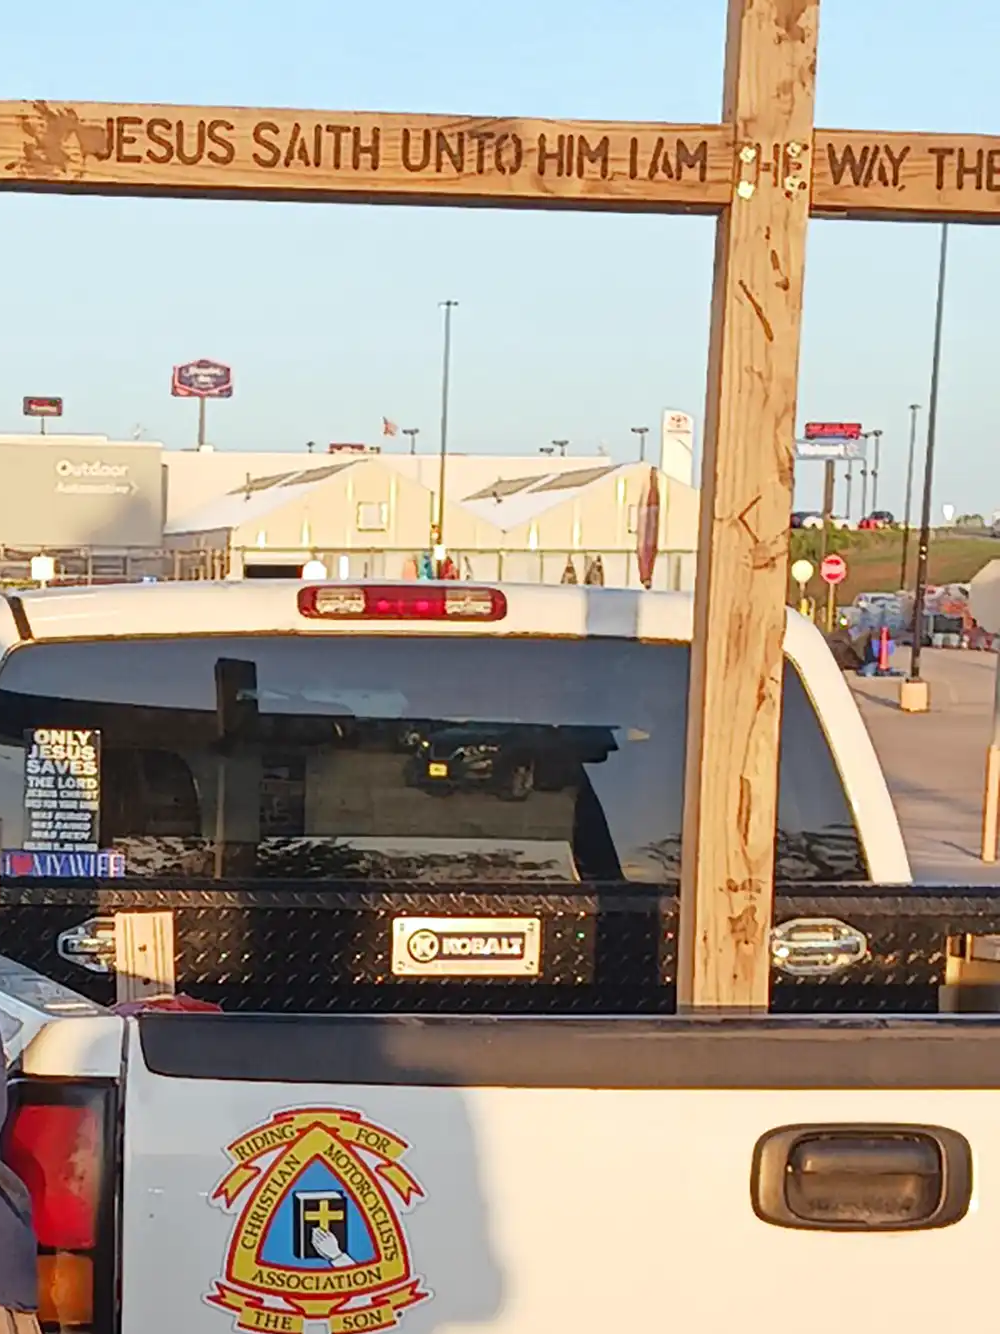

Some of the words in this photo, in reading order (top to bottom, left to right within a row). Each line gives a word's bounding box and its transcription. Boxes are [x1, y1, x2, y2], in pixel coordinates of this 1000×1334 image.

[97, 116, 236, 166] JESUS
[252, 120, 381, 171] SAITH
[401, 127, 523, 176] UNTO
[629, 136, 638, 180] I
[647, 136, 708, 183] AM
[56, 459, 130, 477] Outdoor
[33, 729, 91, 746] ONLY
[28, 745, 96, 760] JESUS
[26, 760, 98, 775] SAVES
[27, 776, 55, 788] THE
[58, 776, 98, 789] LORD
[32, 853, 66, 877] MY
[68, 852, 127, 878] WIFE
[442, 937, 523, 955] KOBALT
[235, 1124, 295, 1162] RIDING
[355, 1126, 391, 1154] FOR
[241, 1153, 301, 1250] CHRISTIAN
[322, 1142, 400, 1262] MOTORCYCLISTS
[251, 1266, 382, 1291] ASSOCIATION
[254, 1311, 293, 1330] THE
[342, 1309, 383, 1330] SON
